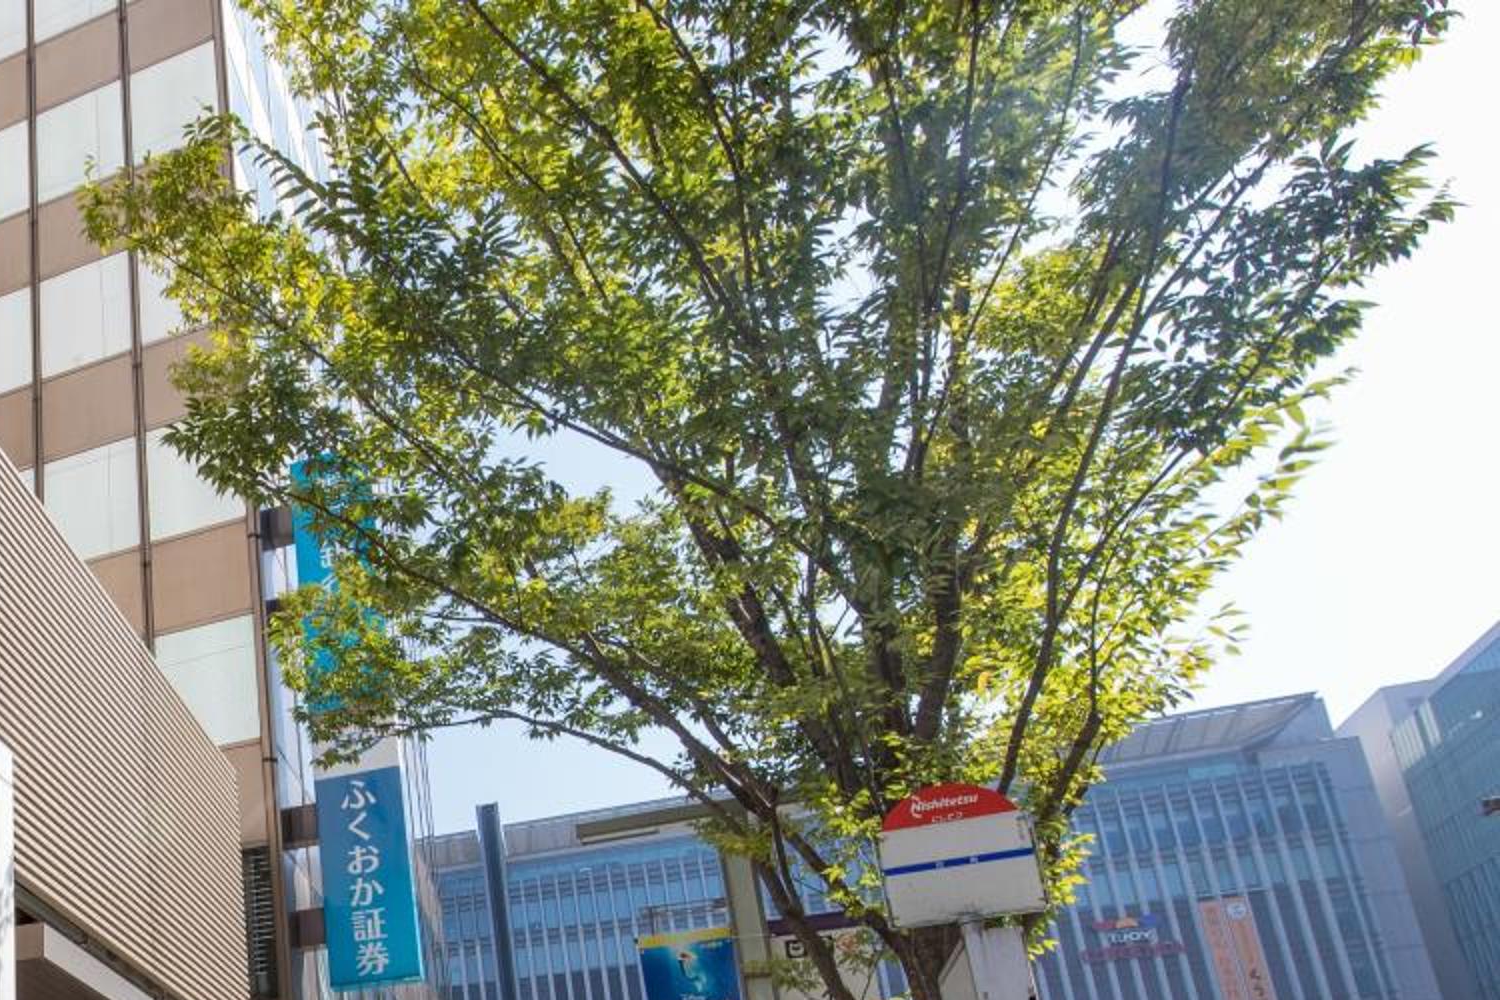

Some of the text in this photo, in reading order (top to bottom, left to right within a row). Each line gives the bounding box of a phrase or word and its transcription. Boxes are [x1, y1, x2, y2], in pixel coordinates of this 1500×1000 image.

[910, 792, 979, 819] Nishitetsu
[340, 779, 390, 977] ふくおか証券
